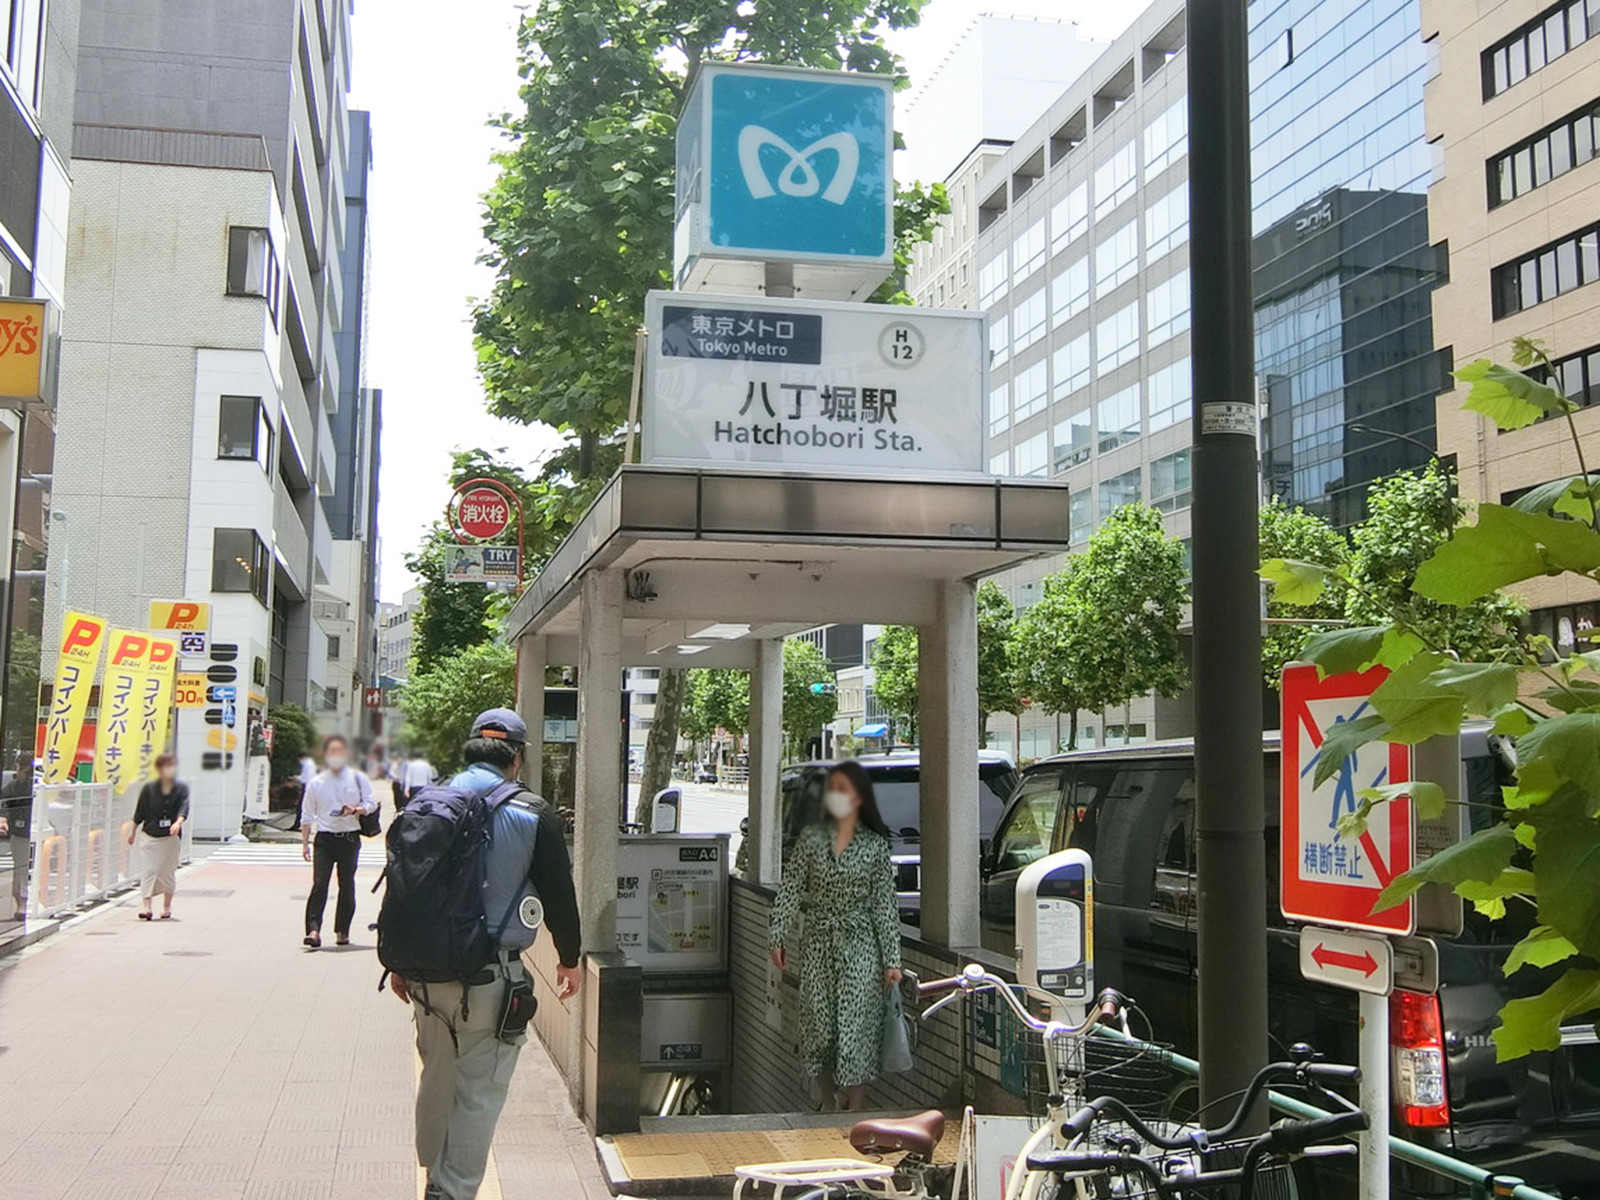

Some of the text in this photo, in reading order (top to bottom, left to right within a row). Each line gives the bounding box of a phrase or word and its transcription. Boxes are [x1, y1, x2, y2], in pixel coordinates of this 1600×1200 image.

[0, 314, 38, 357] y's
[691, 315, 794, 339] 東京メトロ
[895, 330, 907, 343] H
[697, 338, 788, 356] Tokyo Metro
[892, 344, 913, 360] 12
[738, 381, 898, 425] 八丁堀駅
[714, 420, 923, 452] Hatchobori Sta.
[463, 504, 505, 524] 消火栓
[489, 549, 512, 560] TRY
[165, 603, 199, 629] P
[62, 619, 101, 654] P
[112, 635, 149, 665] P
[699, 848, 717, 860] A4
[1304, 840, 1364, 880] 横断禁止
